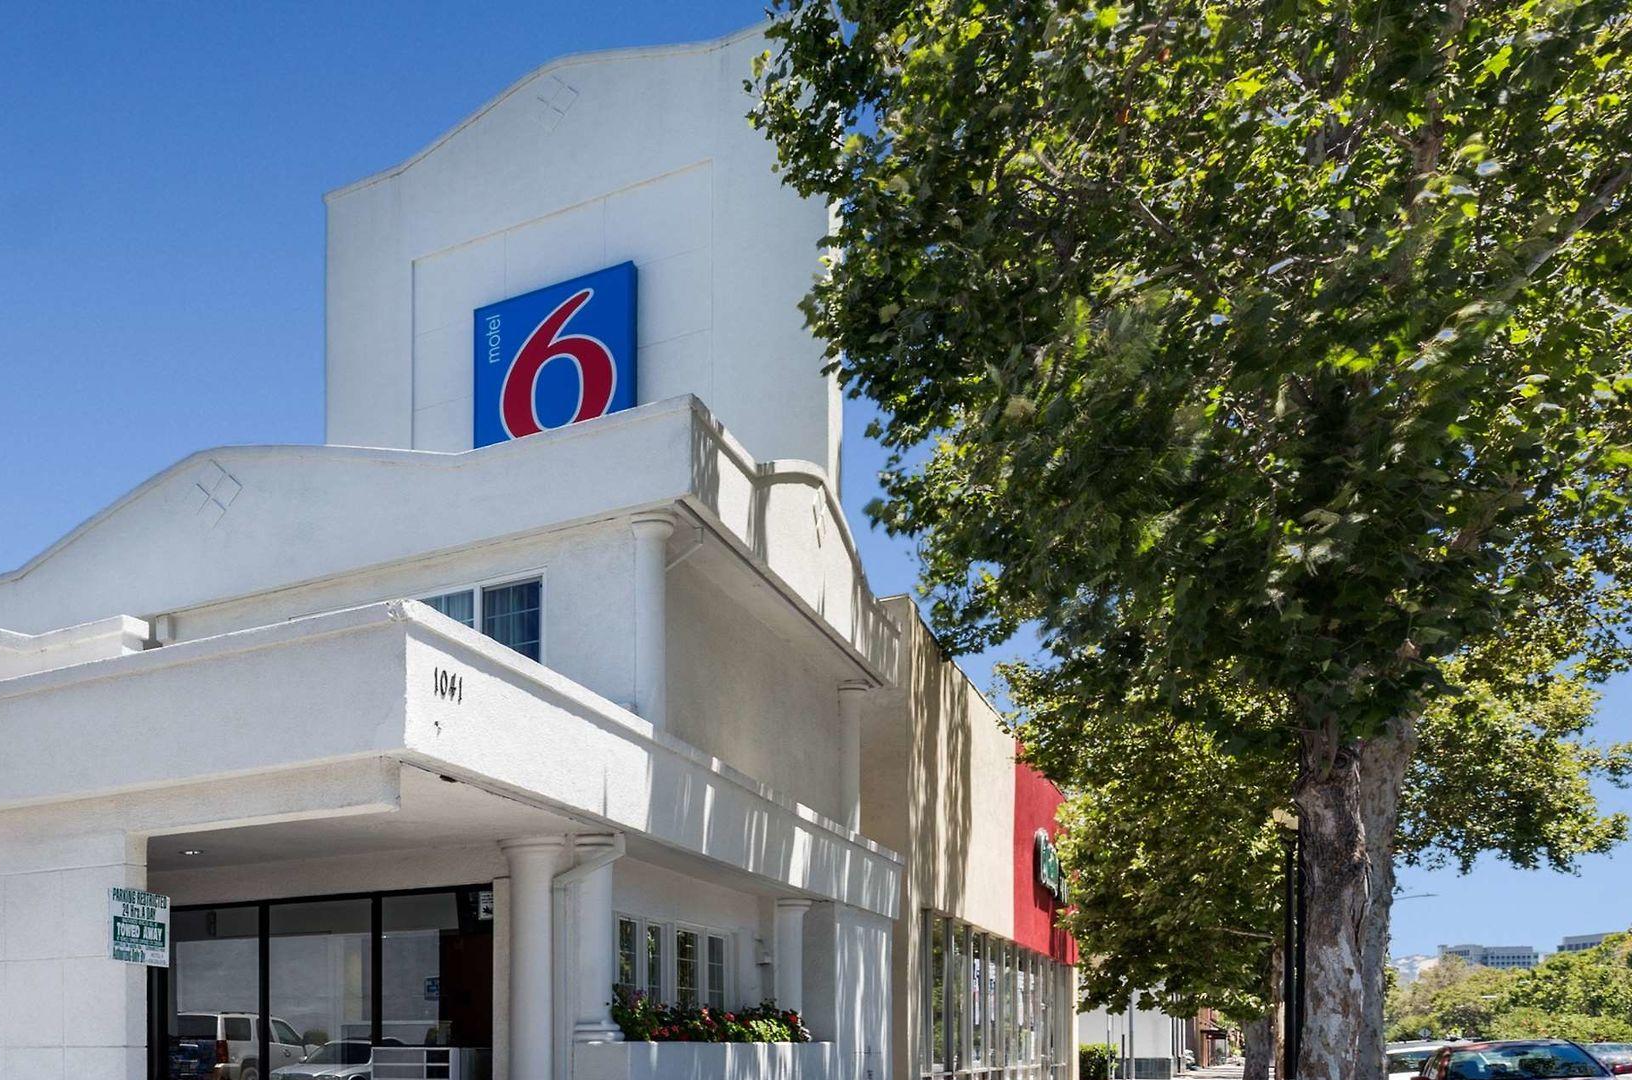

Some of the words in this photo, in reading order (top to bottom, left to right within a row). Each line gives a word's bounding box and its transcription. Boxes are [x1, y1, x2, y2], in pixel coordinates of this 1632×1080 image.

[486, 314, 500, 364] motel
[499, 287, 618, 440] 6
[434, 666, 463, 705] 1041
[112, 887, 136, 904] PARKING
[122, 903, 129, 916] 24
[116, 922, 140, 938] TOWED
[142, 926, 163, 941] AWAY
